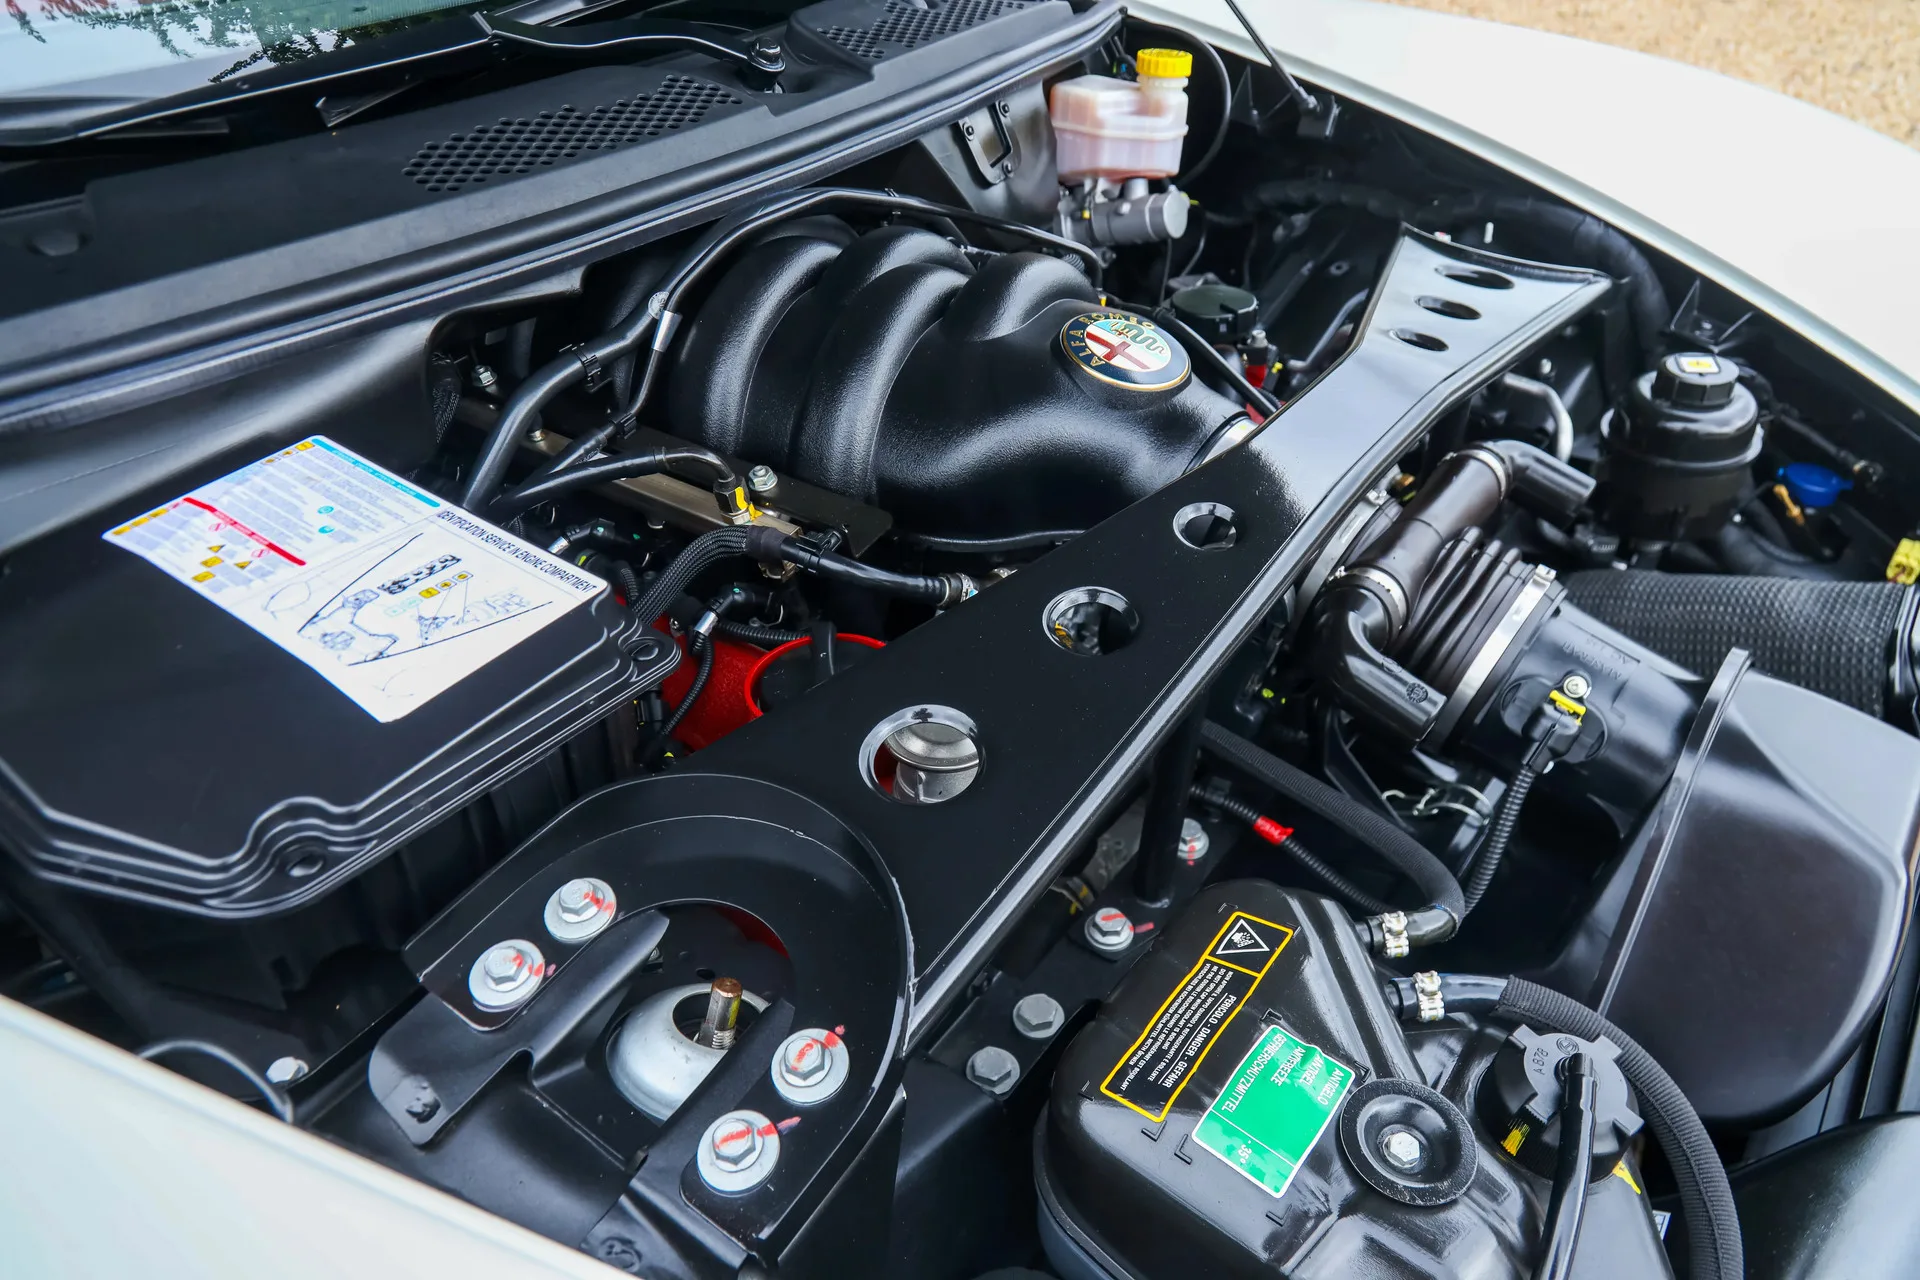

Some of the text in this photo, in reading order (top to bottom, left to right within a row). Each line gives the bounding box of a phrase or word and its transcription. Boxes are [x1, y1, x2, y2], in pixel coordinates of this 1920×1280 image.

[1068, 312, 1154, 366] ALFA ROMEO
[436, 509, 596, 593] IDENTIFICATION SERVICE IN ENGINE COMPARTMENT
[1205, 971, 1214, 979] PAS
[1212, 974, 1221, 983] NOT
[1224, 970, 1233, 980] NON
[1195, 978, 1208, 992] OUVRIR
[1205, 982, 1215, 992] OPEN
[1214, 980, 1227, 994] APRIRE
[1177, 995, 1194, 1014] BOUCHON
[1190, 998, 1202, 1010] WHEN
[1201, 996, 1214, 1008] TAPPO
[1208, 994, 1236, 1024] PERICOLO
[1166, 1013, 1180, 1028] QUAND
[1177, 1009, 1193, 1027] COOLANT
[1189, 1007, 1205, 1024] QUANDO
[1149, 1013, 1171, 1038] KÜHLMITTEL
[1161, 1031, 1176, 1050] BOILING
[1165, 1027, 1189, 1059] REFRIGERANTE
[1185, 1026, 1210, 1057] DANGER
[1136, 1059, 1146, 1068] EST
[1147, 1061, 1166, 1081] BOLLENTE
[1220, 1031, 1287, 1113] GEFRIERSCHUTZMITTEL
[1269, 1046, 1306, 1086] ANTIFREEZE
[1299, 1054, 1324, 1086] ANTIGEL
[1119, 1067, 1139, 1090] BOUILLANT
[1162, 1060, 1189, 1088] GEFAHR
[1316, 1068, 1344, 1106] ANTIGELO
